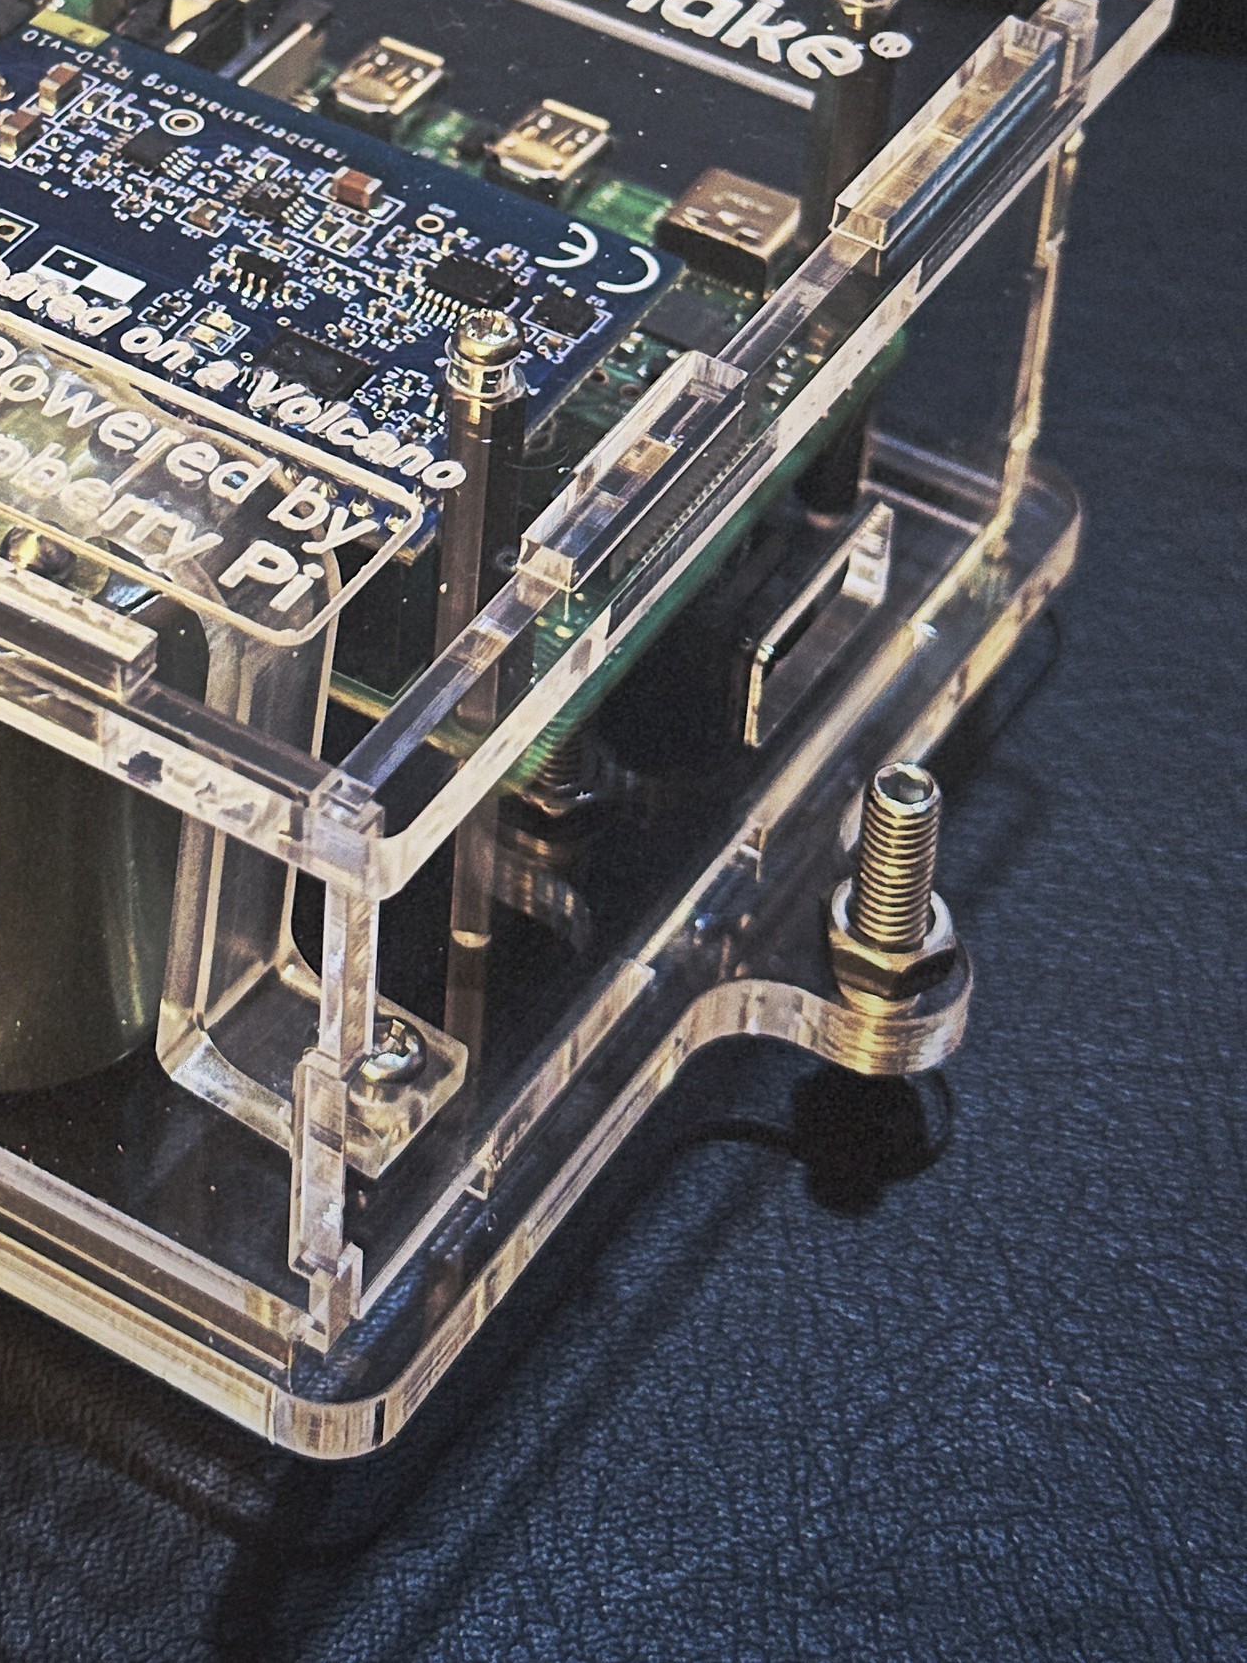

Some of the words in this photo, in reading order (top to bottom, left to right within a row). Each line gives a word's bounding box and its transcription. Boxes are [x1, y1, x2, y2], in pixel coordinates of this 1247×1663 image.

[21, 29, 134, 81] RS1D-v10
[140, 71, 349, 164] raspberryshake.org
[119, 324, 200, 373] on
[194, 359, 241, 391] a
[248, 368, 467, 490] Volcano
[267, 475, 380, 555] by
[218, 540, 326, 615] Pi
